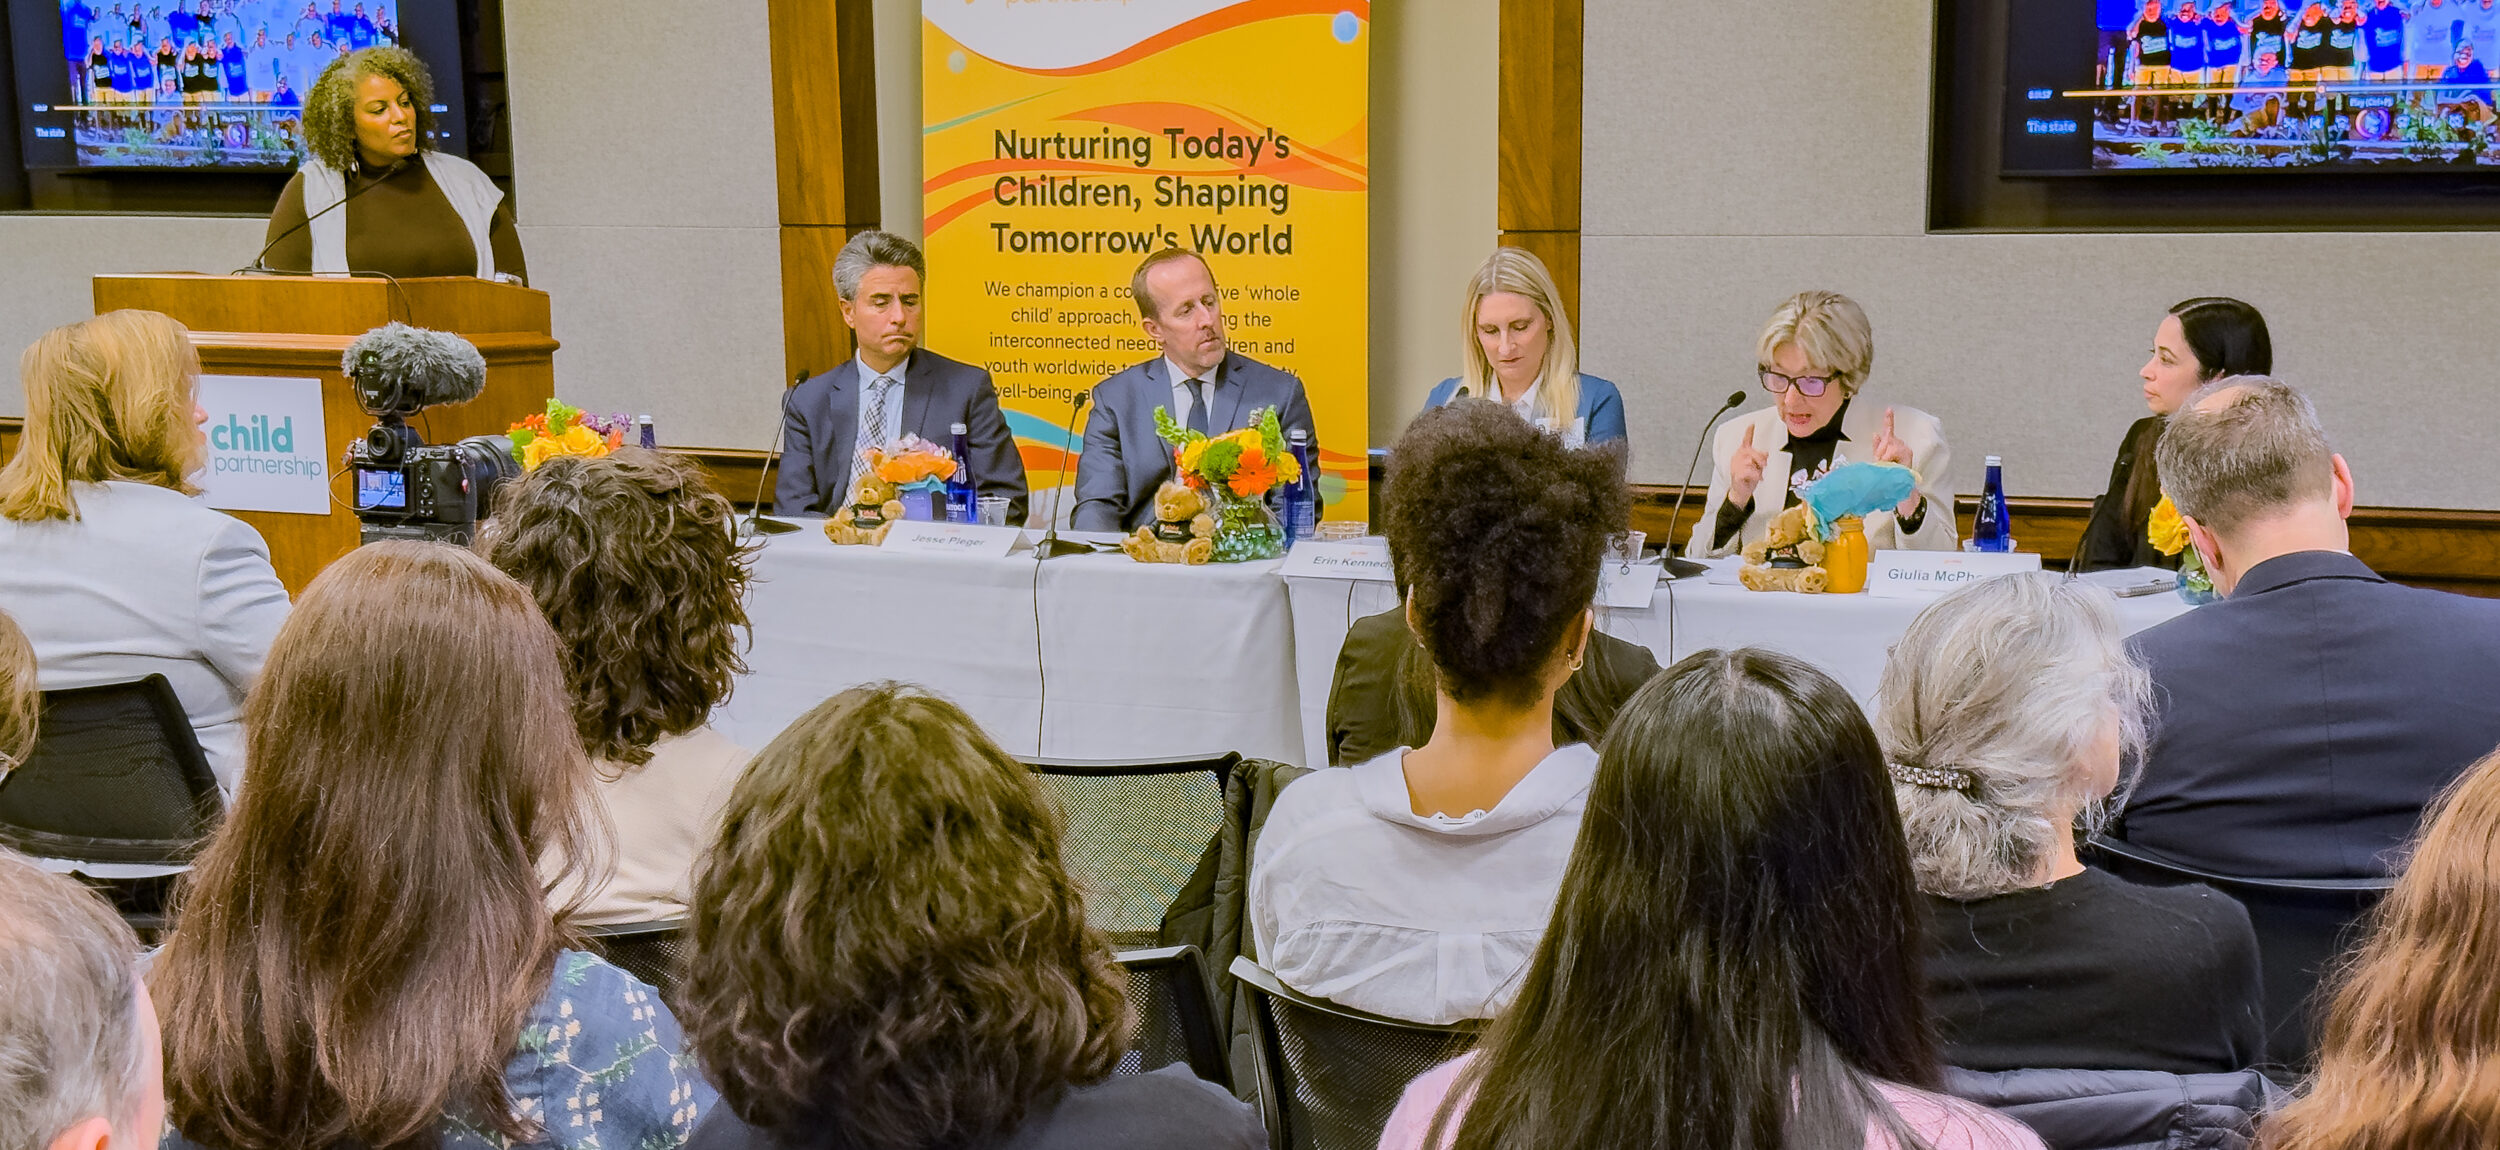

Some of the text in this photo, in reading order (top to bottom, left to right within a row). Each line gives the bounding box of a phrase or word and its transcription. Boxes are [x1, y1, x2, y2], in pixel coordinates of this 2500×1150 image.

[2026, 119, 2048, 134] The
[994, 127, 1290, 167] Nurturing Today's
[994, 175, 1288, 215] Children, Shaping
[990, 223, 1293, 254] Tomorrow's World
[985, 281, 1011, 297] We
[1015, 282, 1094, 301] champion
[1100, 287, 1108, 298] a
[1058, 309, 1137, 327] approach,
[1244, 311, 1272, 327] the
[990, 332, 1111, 349] interconnected
[1264, 338, 1295, 354] and
[985, 359, 1028, 373] youth
[1034, 360, 1116, 375] worldwide
[211, 414, 294, 453] child
[214, 454, 322, 480] partnership
[912, 534, 946, 544] Jesse
[1313, 556, 1389, 569] Erin Kenned
[1888, 568, 1930, 581] Giulia
